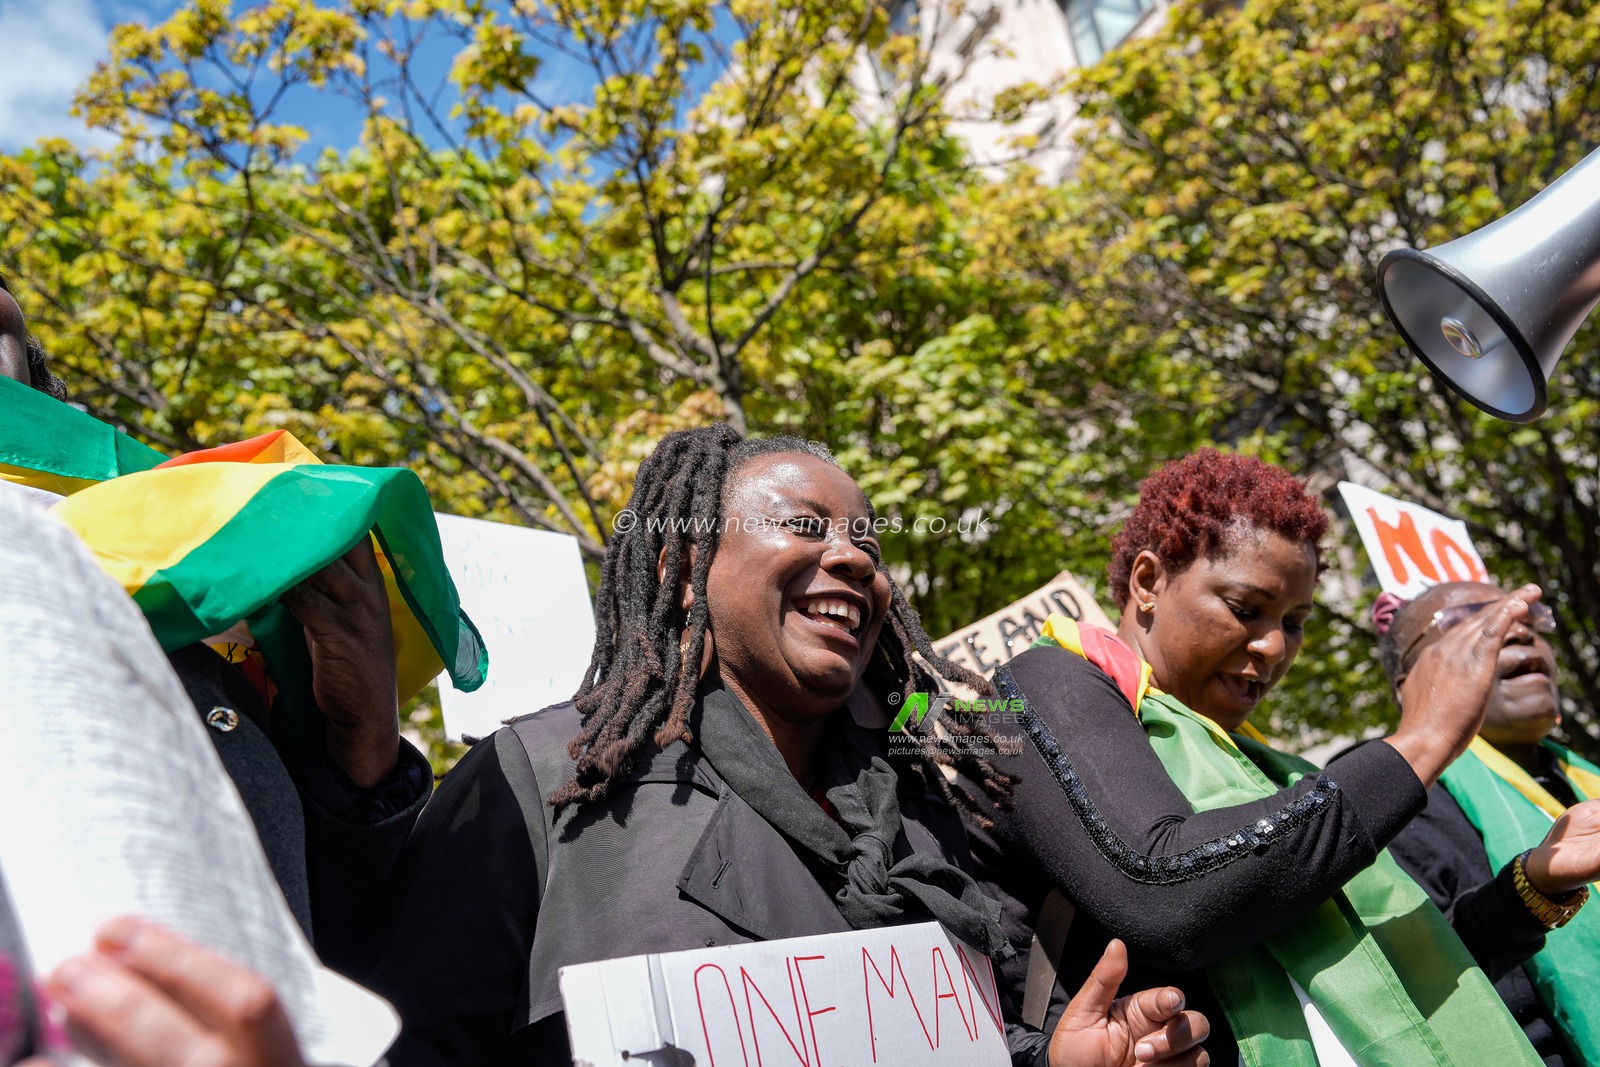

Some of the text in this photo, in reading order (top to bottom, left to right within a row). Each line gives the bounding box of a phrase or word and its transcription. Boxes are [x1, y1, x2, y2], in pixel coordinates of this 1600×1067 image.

[1366, 505, 1482, 583] NO
[999, 589, 1082, 658] AND
[694, 943, 1004, 1067] ONE MAN
